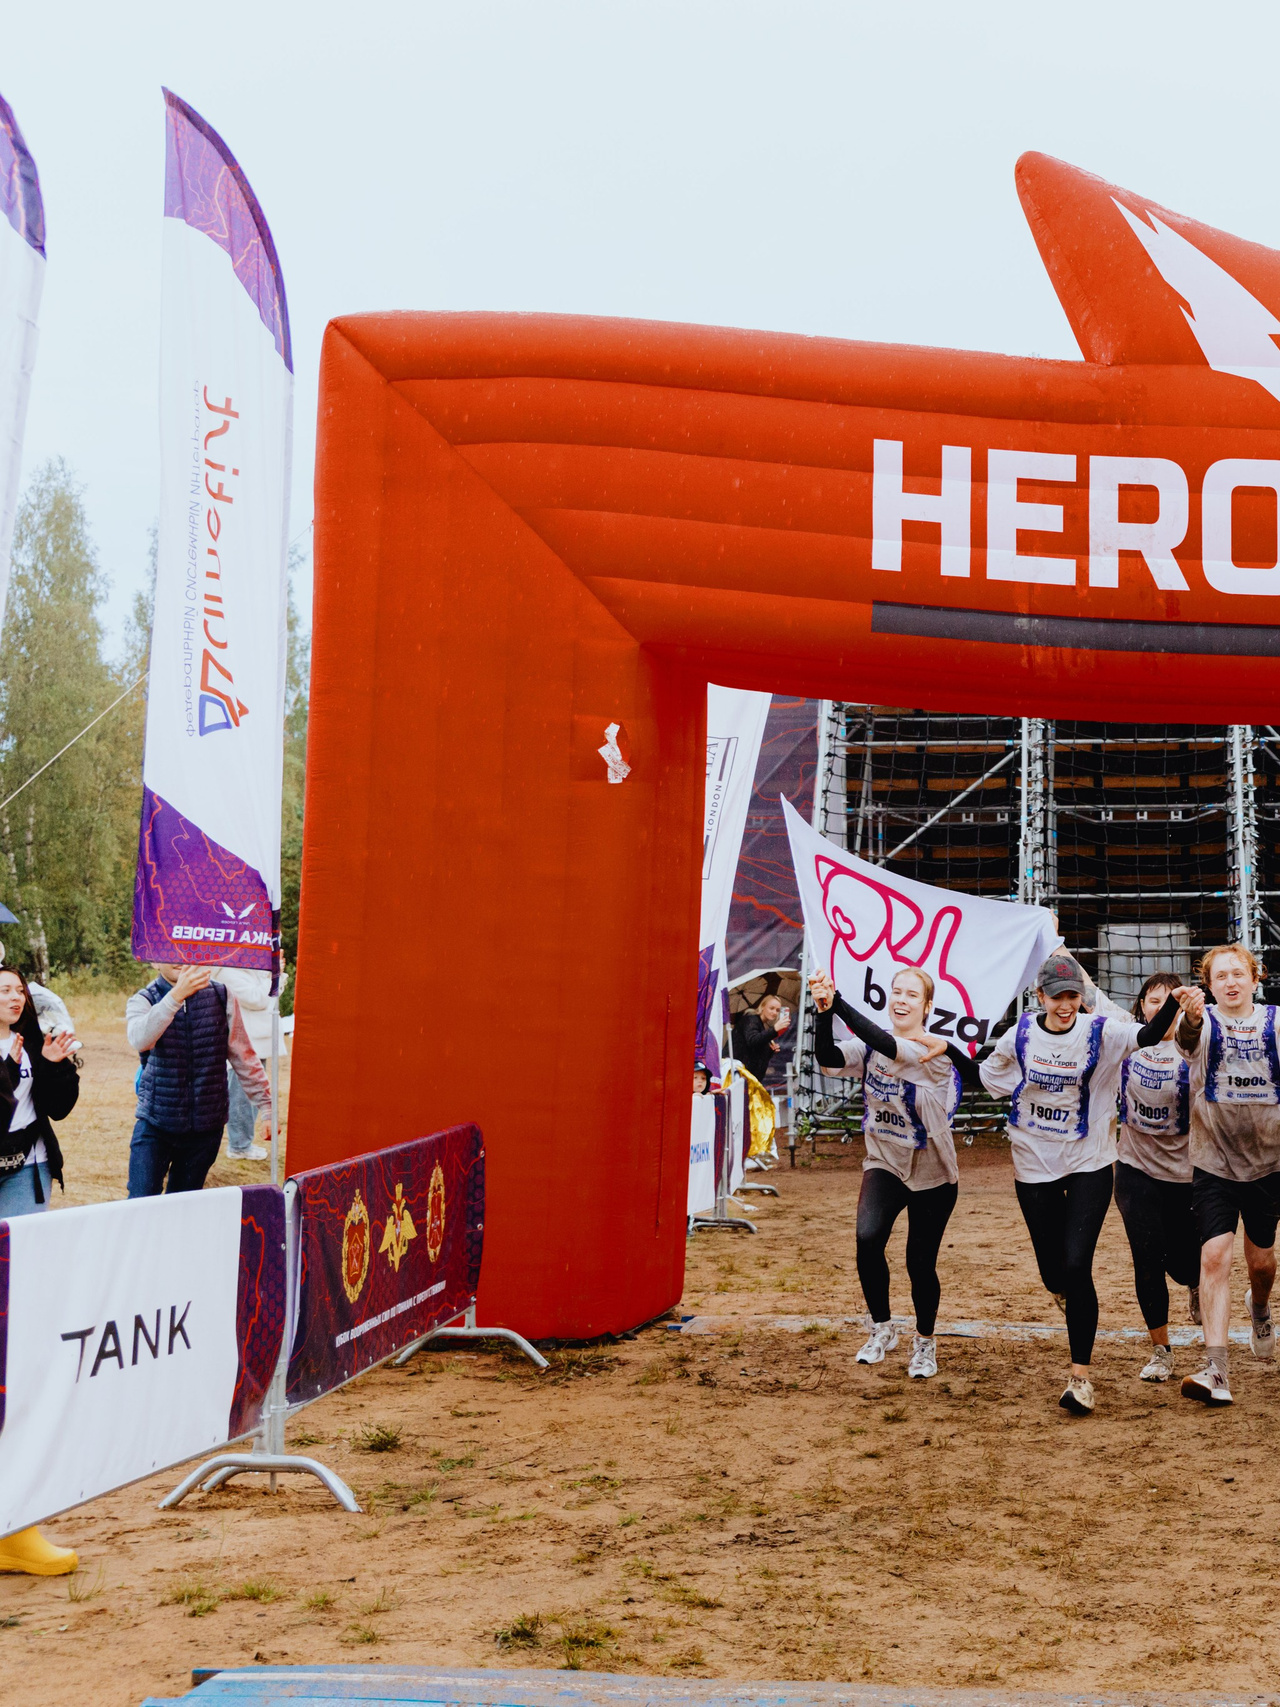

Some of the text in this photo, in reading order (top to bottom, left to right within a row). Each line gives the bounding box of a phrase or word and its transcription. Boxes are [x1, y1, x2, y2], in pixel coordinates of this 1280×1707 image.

[707, 784, 722, 832] LONDON
[864, 966, 990, 1045] bza
[1029, 1070, 1076, 1085] КОМАНДНЫЙ
[1041, 1083, 1063, 1092] СТАРТ
[1141, 1077, 1161, 1089] СТАРТ
[1030, 1102, 1070, 1122] 19007
[1133, 1099, 1170, 1120] 19009
[60, 1300, 192, 1364] TANK
